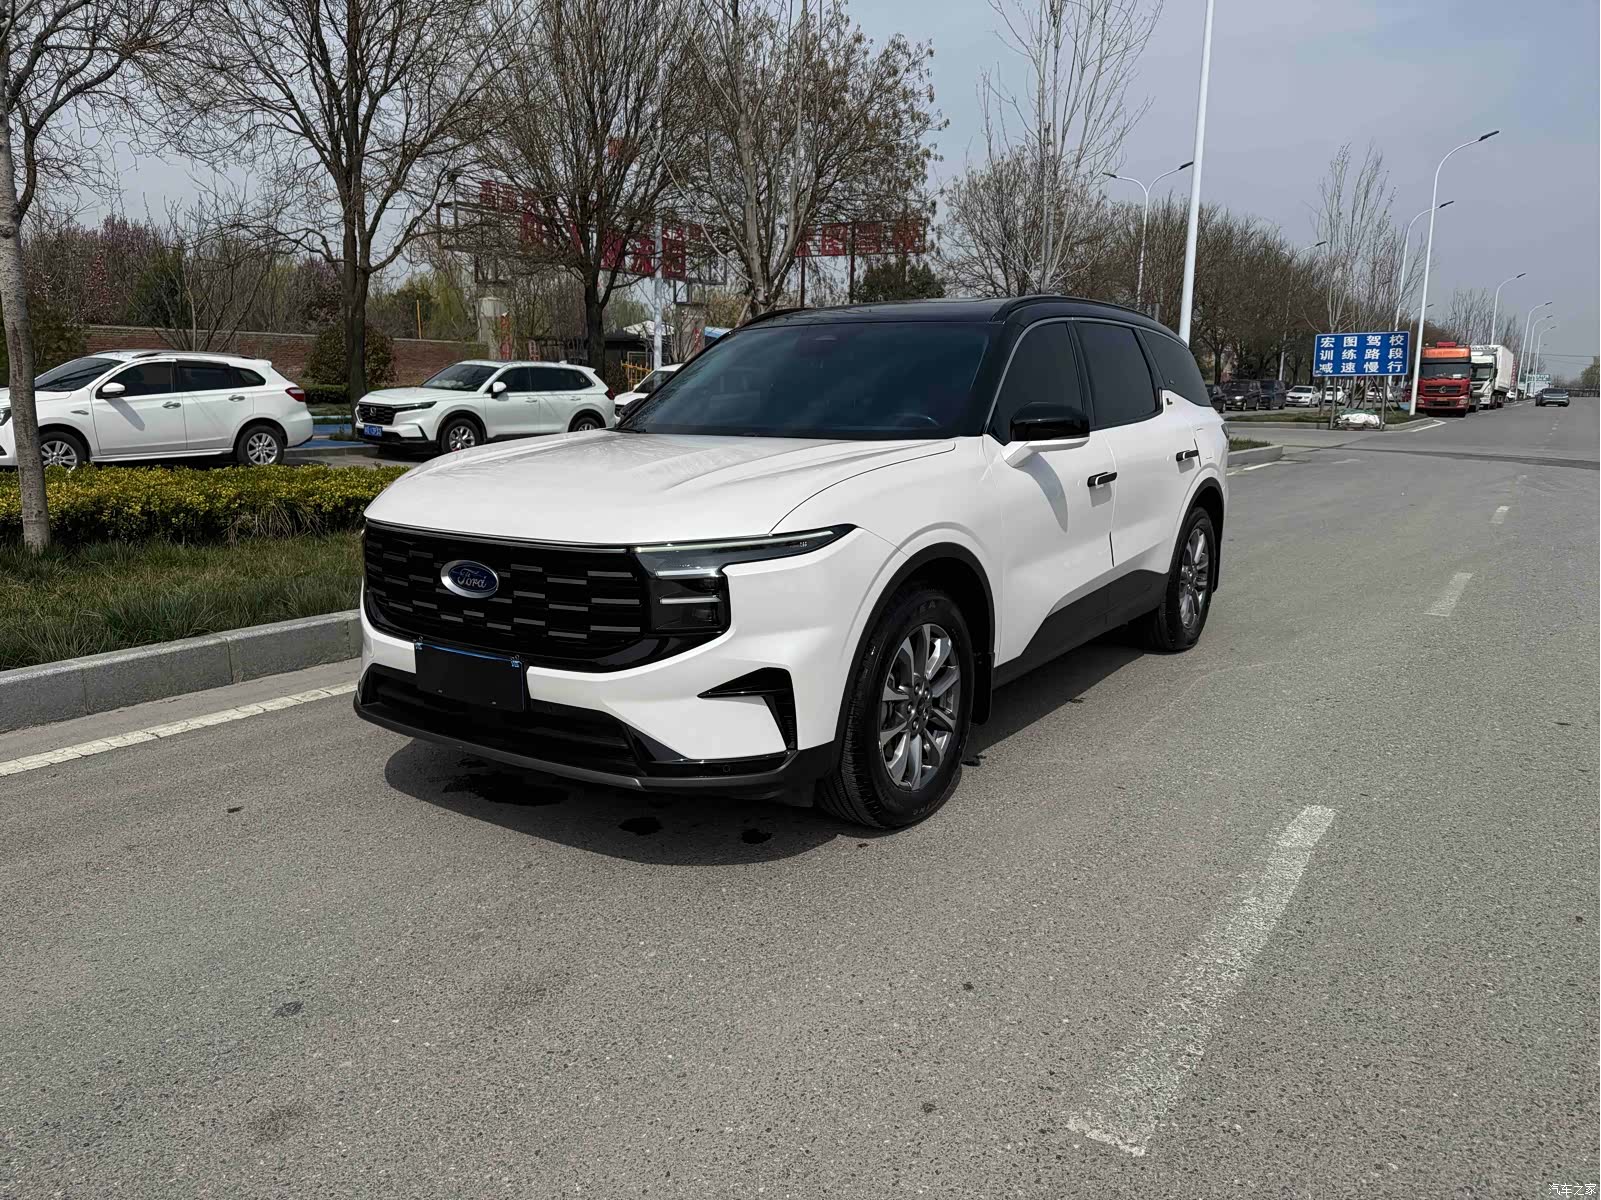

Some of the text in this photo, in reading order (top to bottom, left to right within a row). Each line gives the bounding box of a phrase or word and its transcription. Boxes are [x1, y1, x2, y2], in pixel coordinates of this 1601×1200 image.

[1320, 334, 1405, 348] 宏图驾校
[1319, 348, 1404, 360] 训练路段
[1319, 361, 1403, 373] 减速慢行
[457, 568, 487, 589] Ford
